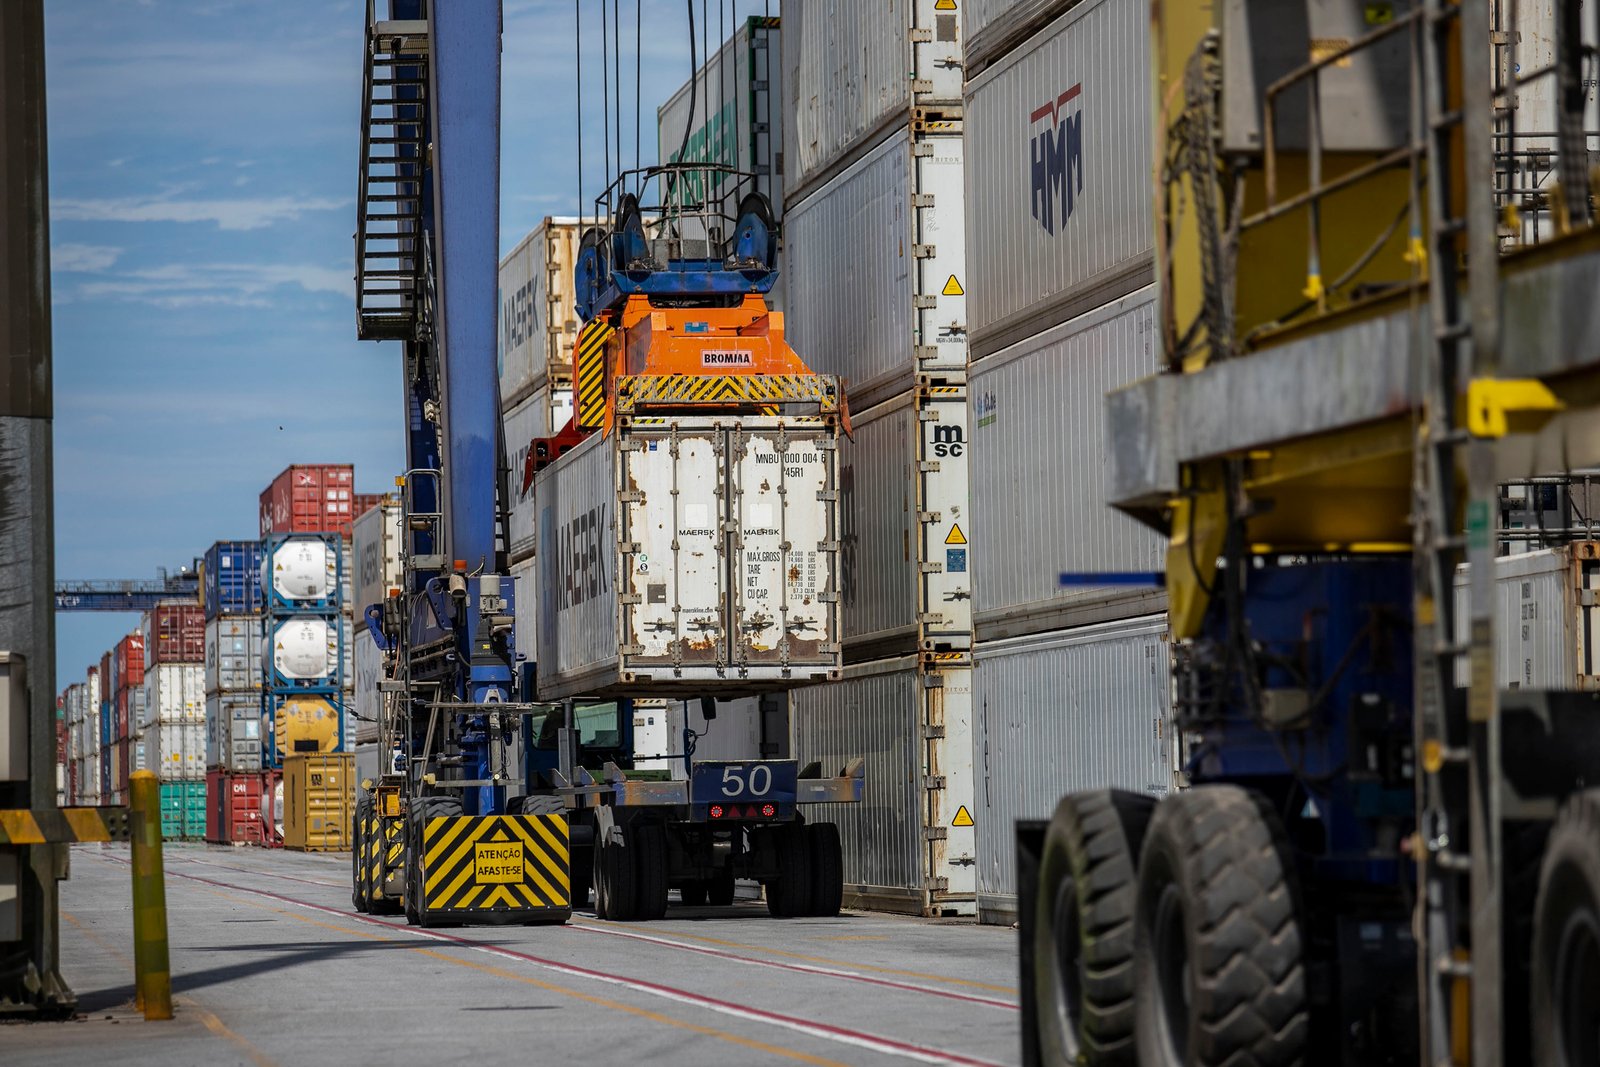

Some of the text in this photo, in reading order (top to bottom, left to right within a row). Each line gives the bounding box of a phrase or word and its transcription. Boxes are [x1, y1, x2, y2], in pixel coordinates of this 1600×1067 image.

[1031, 109, 1083, 237] HMM
[504, 273, 538, 356] MAERSK
[704, 353, 750, 363] BROMMA
[756, 453, 779, 464] MNBU
[784, 453, 800, 463] 000
[803, 453, 818, 463] 004
[785, 467, 804, 478] 45R1
[556, 503, 607, 612] MAERSK
[748, 564, 761, 574] TARE
[747, 577, 758, 586] NET
[721, 764, 772, 797] 50
[478, 848, 521, 861] ATENÇÃO
[477, 866, 521, 876] AFASTE-SE
